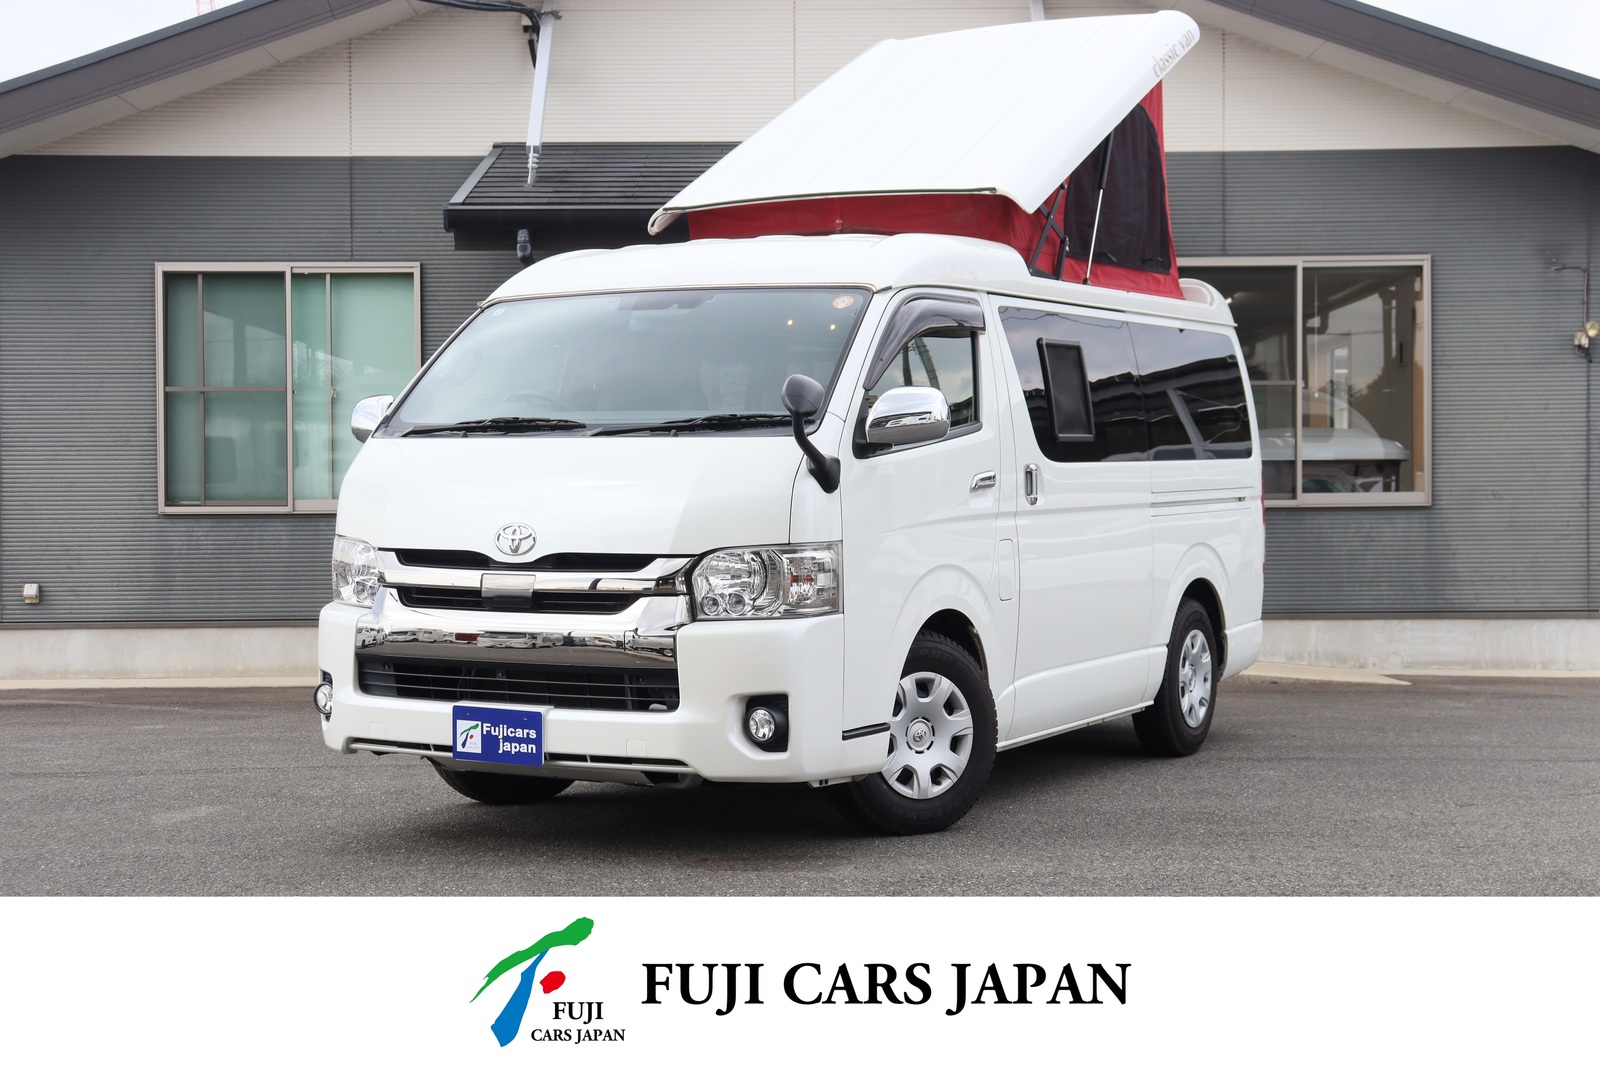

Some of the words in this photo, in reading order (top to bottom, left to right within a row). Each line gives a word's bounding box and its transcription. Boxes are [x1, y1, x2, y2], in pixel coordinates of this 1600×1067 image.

[1152, 43, 1180, 78] classic
[1177, 29, 1196, 51] van
[482, 723, 537, 739] Fujicars
[498, 739, 537, 754] japan
